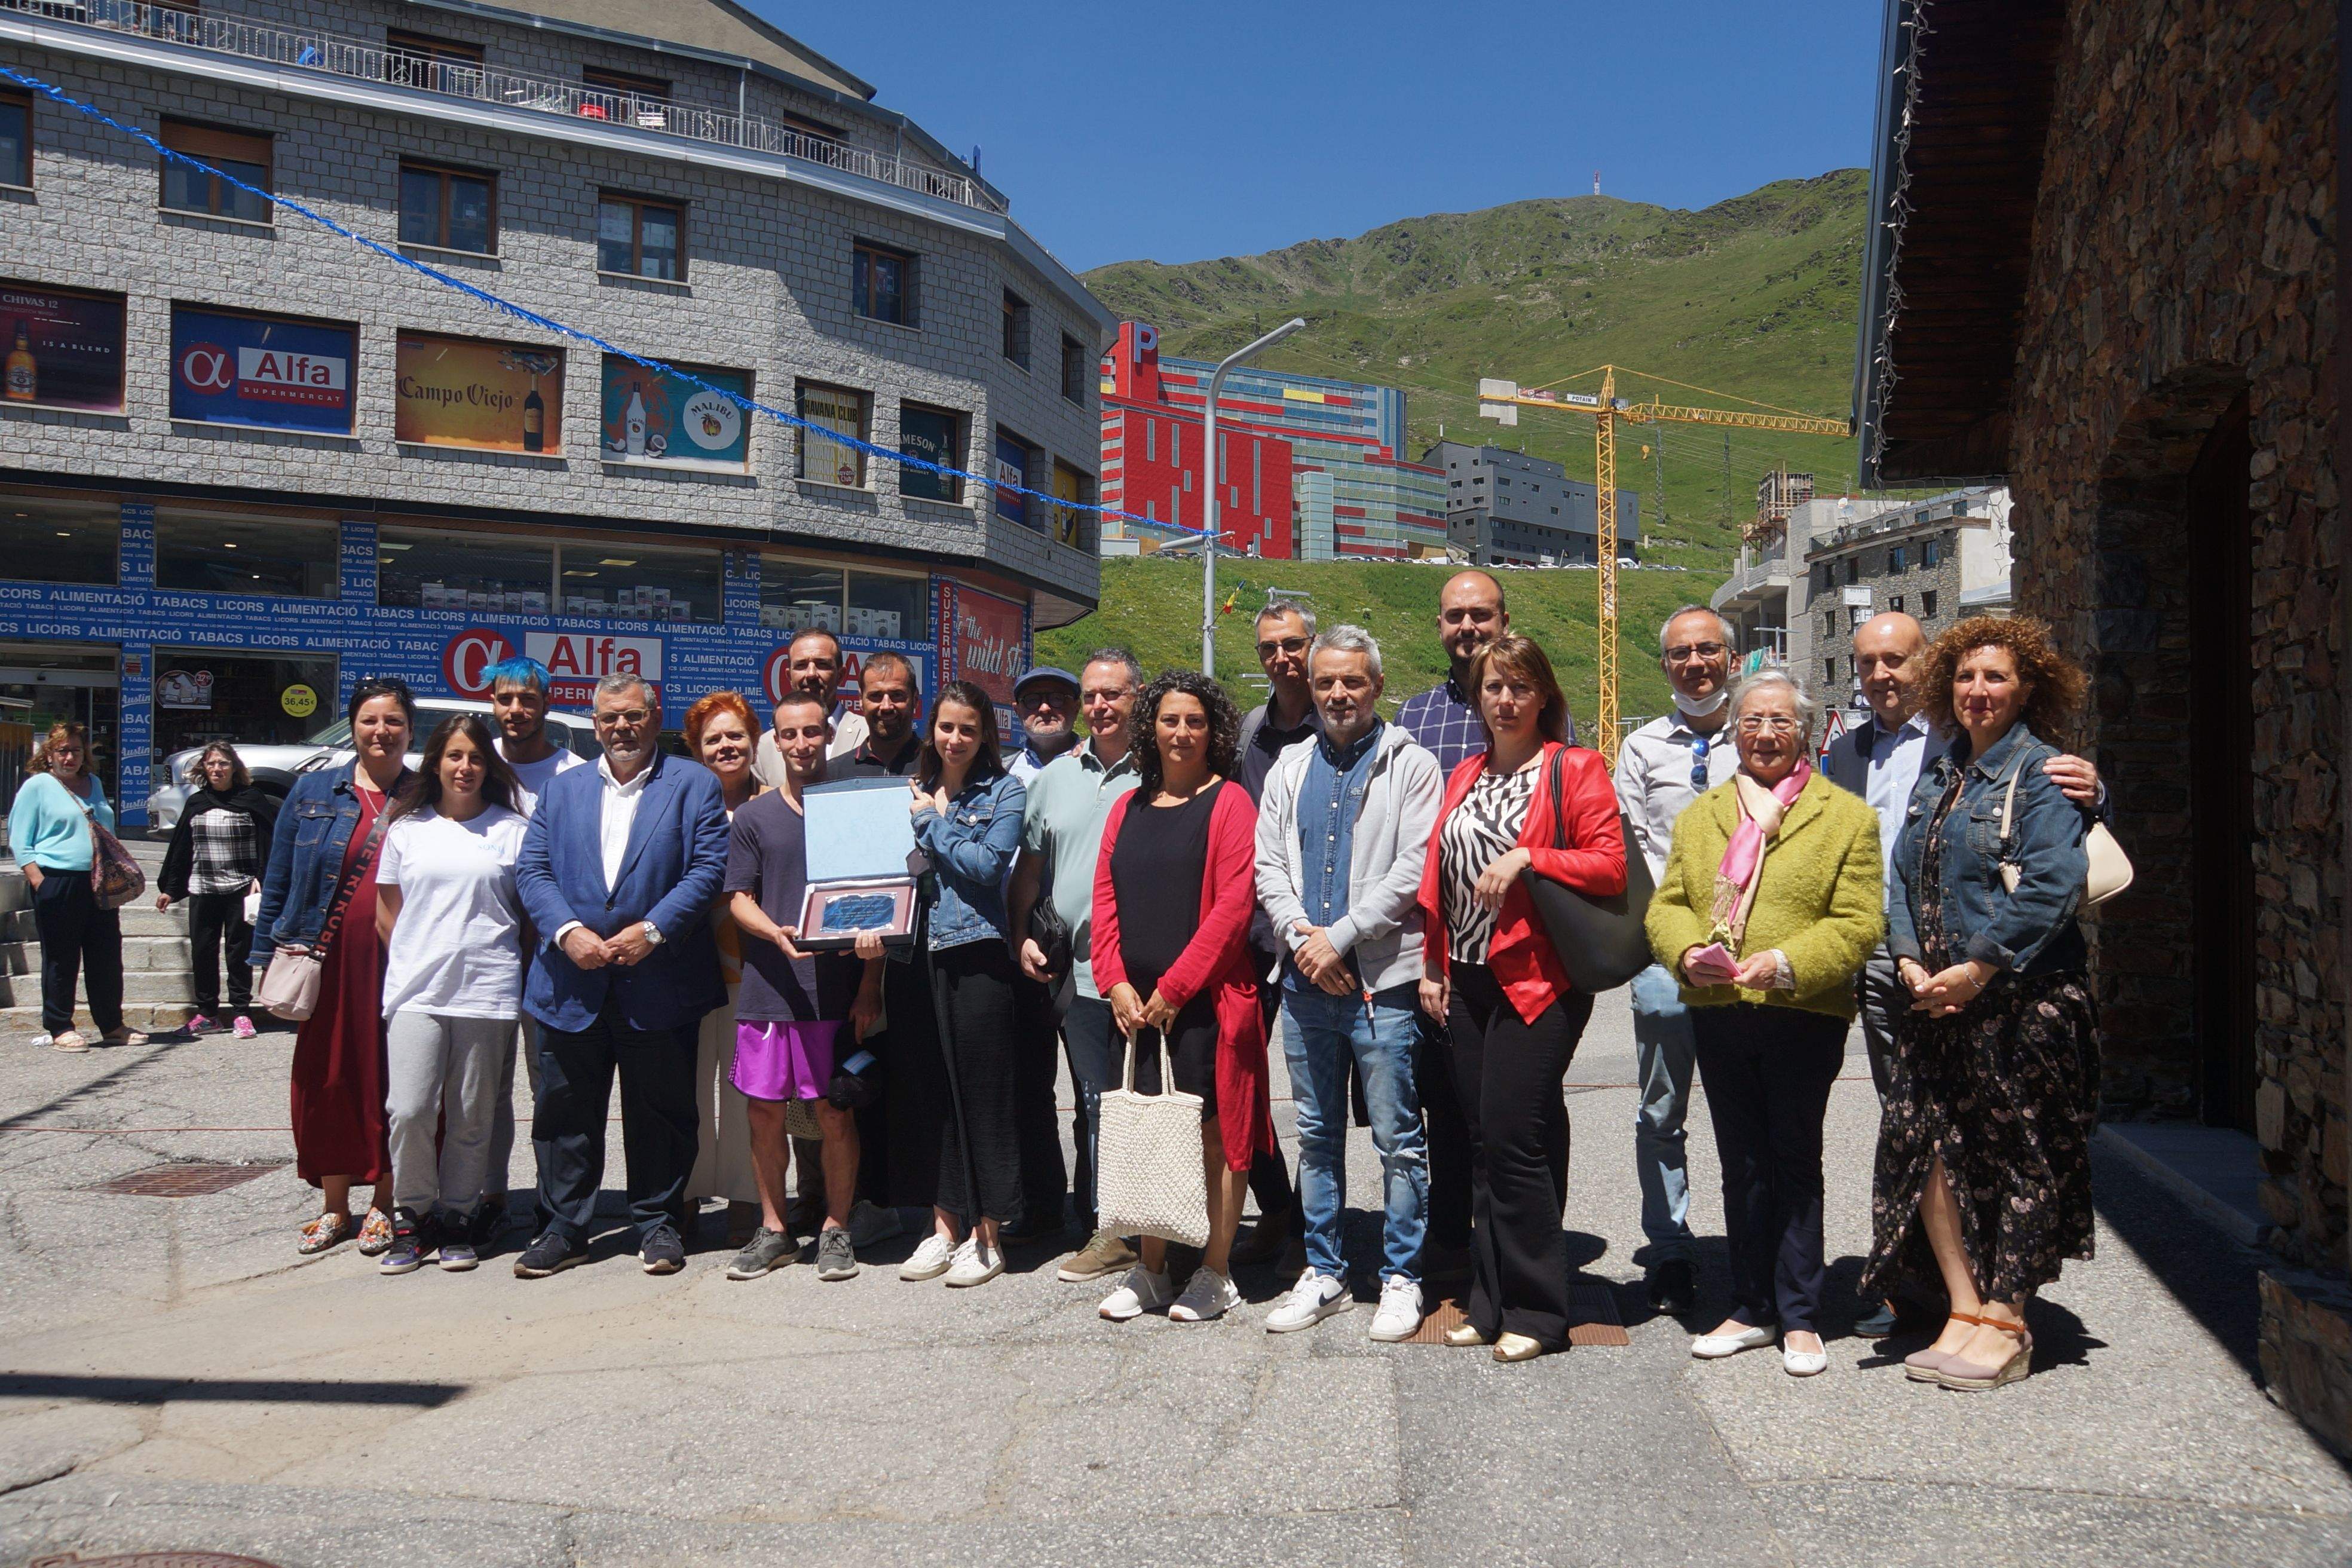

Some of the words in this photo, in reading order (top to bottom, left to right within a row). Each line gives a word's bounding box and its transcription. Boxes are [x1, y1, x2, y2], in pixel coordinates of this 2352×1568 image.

[2, 294, 45, 307] CHIVAS
[48, 300, 59, 308] 12
[72, 344, 111, 353] BLEND
[1134, 322, 1157, 363] P
[255, 353, 330, 385] Alfa
[244, 387, 341, 402] SUPERMERCAT
[398, 375, 463, 408] Campo
[466, 383, 513, 414] Viejo
[690, 402, 734, 420] MALIBU
[805, 399, 835, 419] HAVANA
[838, 406, 858, 422] CLUB
[999, 463, 1018, 487] Alfa
[89, 607, 134, 615] ALIMENTACIÓ
[724, 598, 761, 609] LICORS
[0, 587, 42, 600] CORS
[50, 590, 145, 605] ALIMENTACIÓ
[152, 596, 208, 609] TABACS
[216, 599, 264, 612] LICORS
[272, 604, 358, 617] ALIMENTACIÓ
[365, 608, 415, 619] TABACS
[421, 610, 466, 622] LICORS
[470, 614, 550, 627] ALIMENTACIÓ
[555, 617, 601, 629] TABACS
[607, 620, 648, 632] LICORS
[654, 623, 727, 636] ALIMENTACIÓ
[733, 627, 773, 639] TABACS
[873, 638, 906, 650] TABACS
[966, 615, 983, 641] the
[27, 623, 81, 635] LICORS
[88, 626, 182, 641] ALIMENTACIÓ
[188, 631, 244, 644] TABACS
[251, 634, 299, 646] LICORS
[305, 636, 391, 650] ALIMENTACIÓ
[397, 640, 439, 651] TABAC
[547, 636, 642, 679] Alfa
[670, 653, 678, 663] S
[684, 654, 755, 666] ALIMENTACIÓ
[966, 635, 1004, 675] wild
[666, 684, 681, 693] CS
